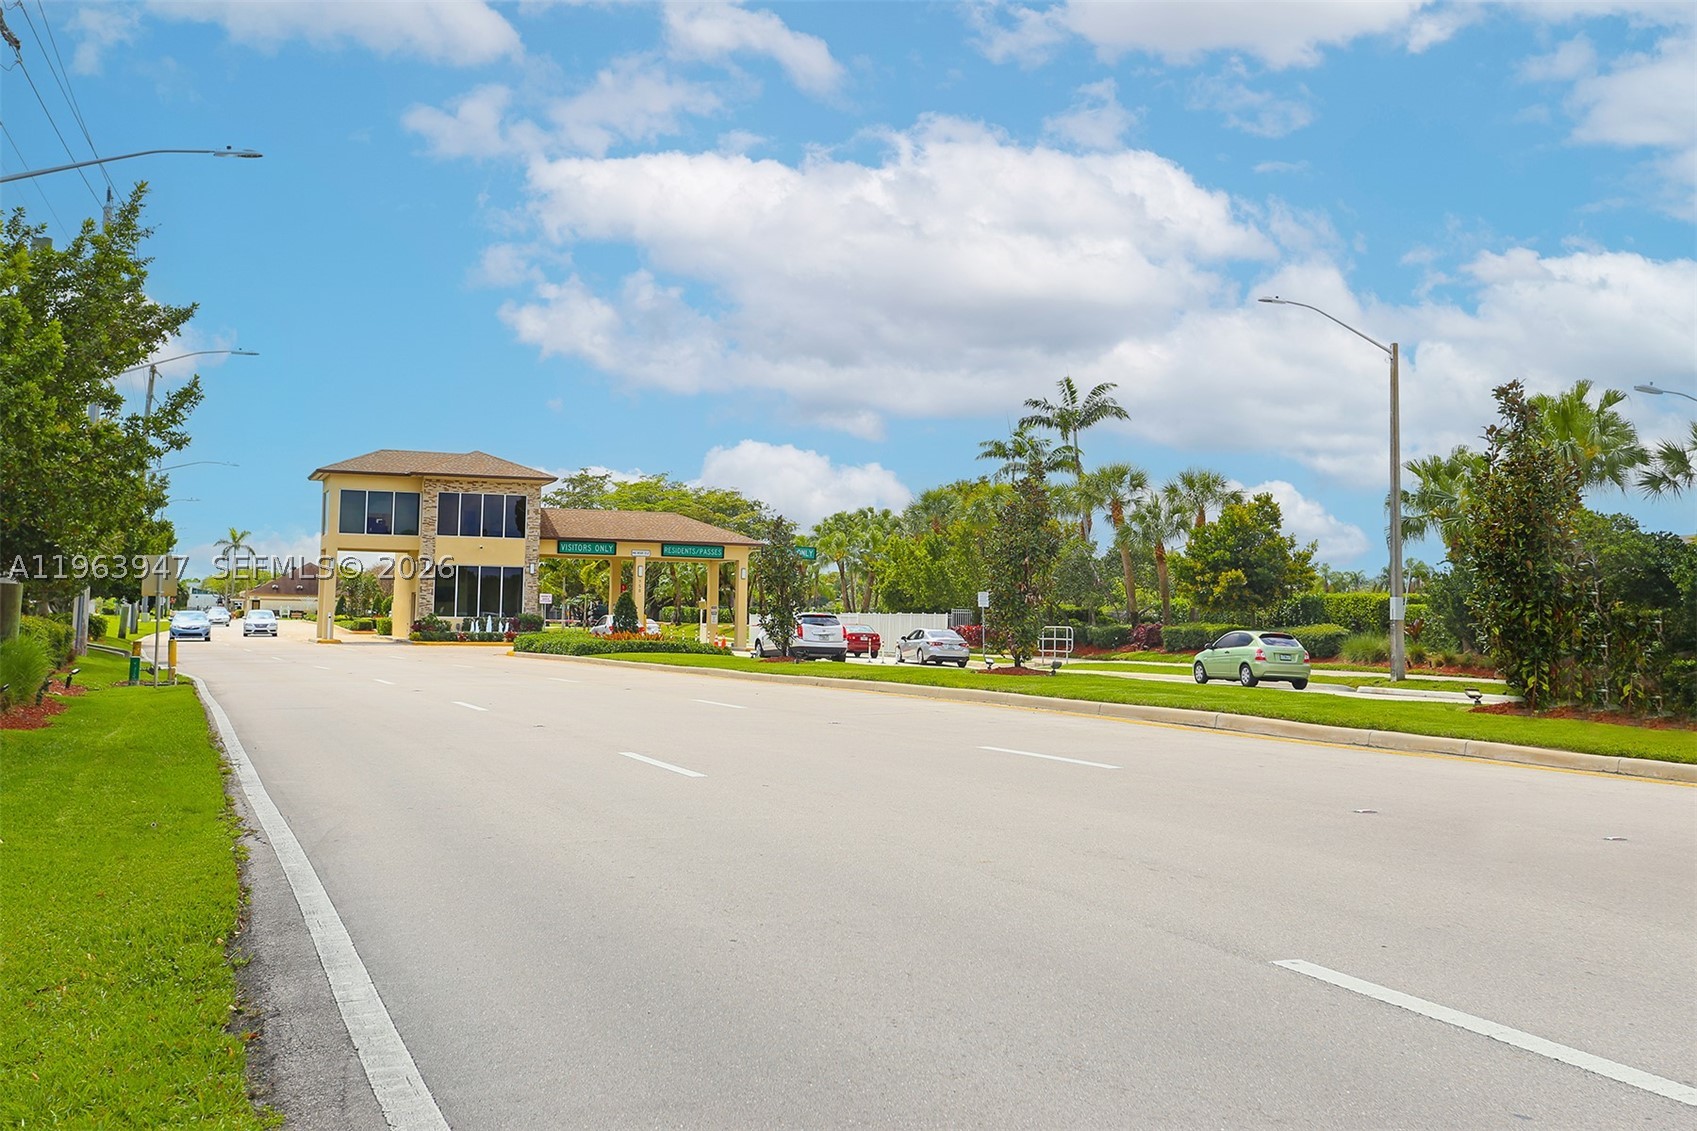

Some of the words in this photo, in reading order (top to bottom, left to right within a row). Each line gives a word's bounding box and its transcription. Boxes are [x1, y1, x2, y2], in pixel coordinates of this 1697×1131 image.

[560, 543, 592, 552] VISITORS
[594, 544, 614, 553] ONLY
[663, 546, 722, 556] RESIDENTS/PASSES
